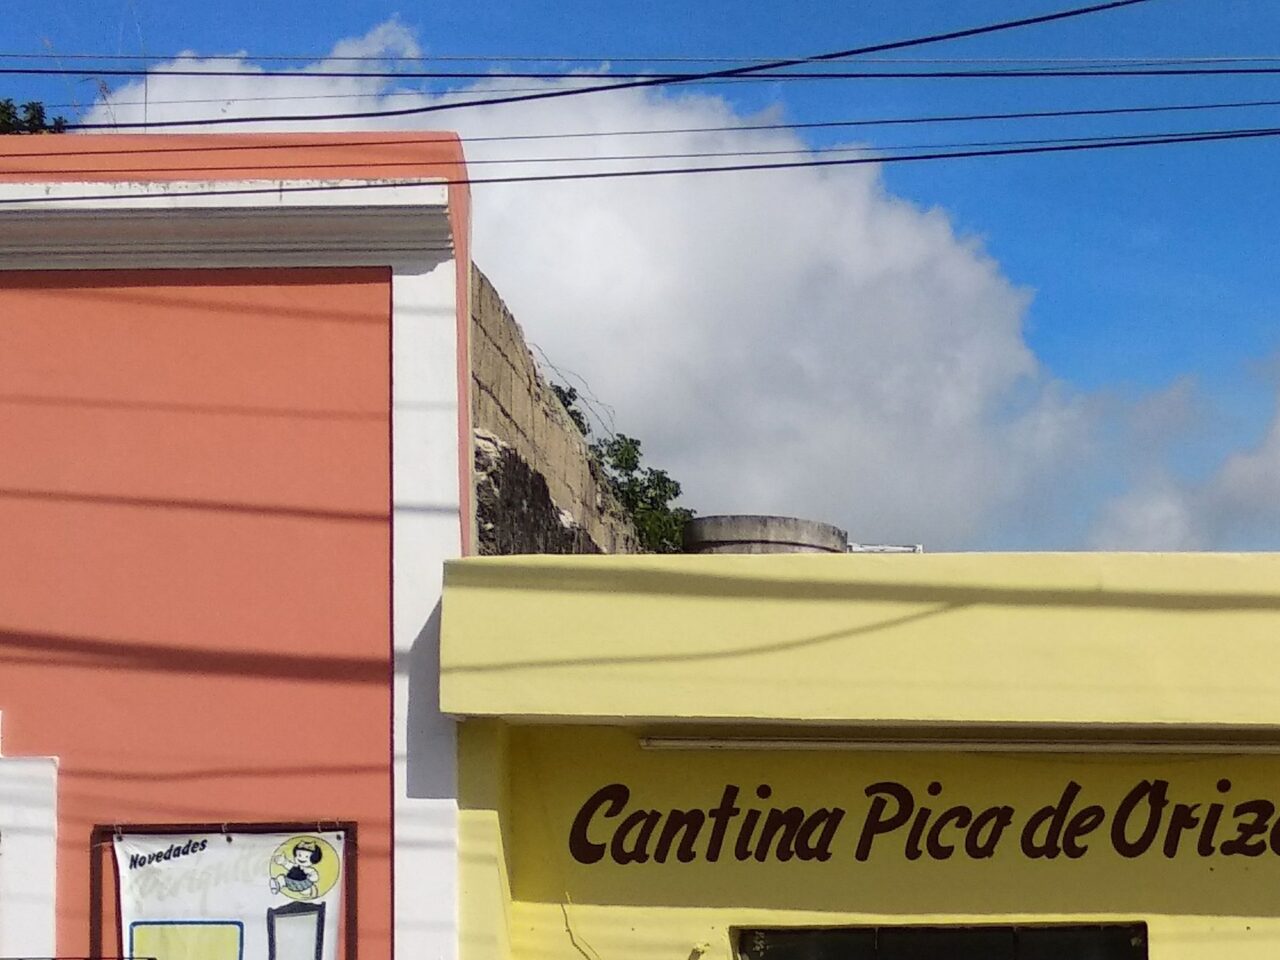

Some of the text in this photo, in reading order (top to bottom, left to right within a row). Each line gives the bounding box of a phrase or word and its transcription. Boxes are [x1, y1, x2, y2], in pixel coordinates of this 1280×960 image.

[568, 783, 846, 865] Cantina
[854, 781, 1015, 861] Pico
[1020, 780, 1105, 859] de
[129, 839, 208, 870] Novedades
